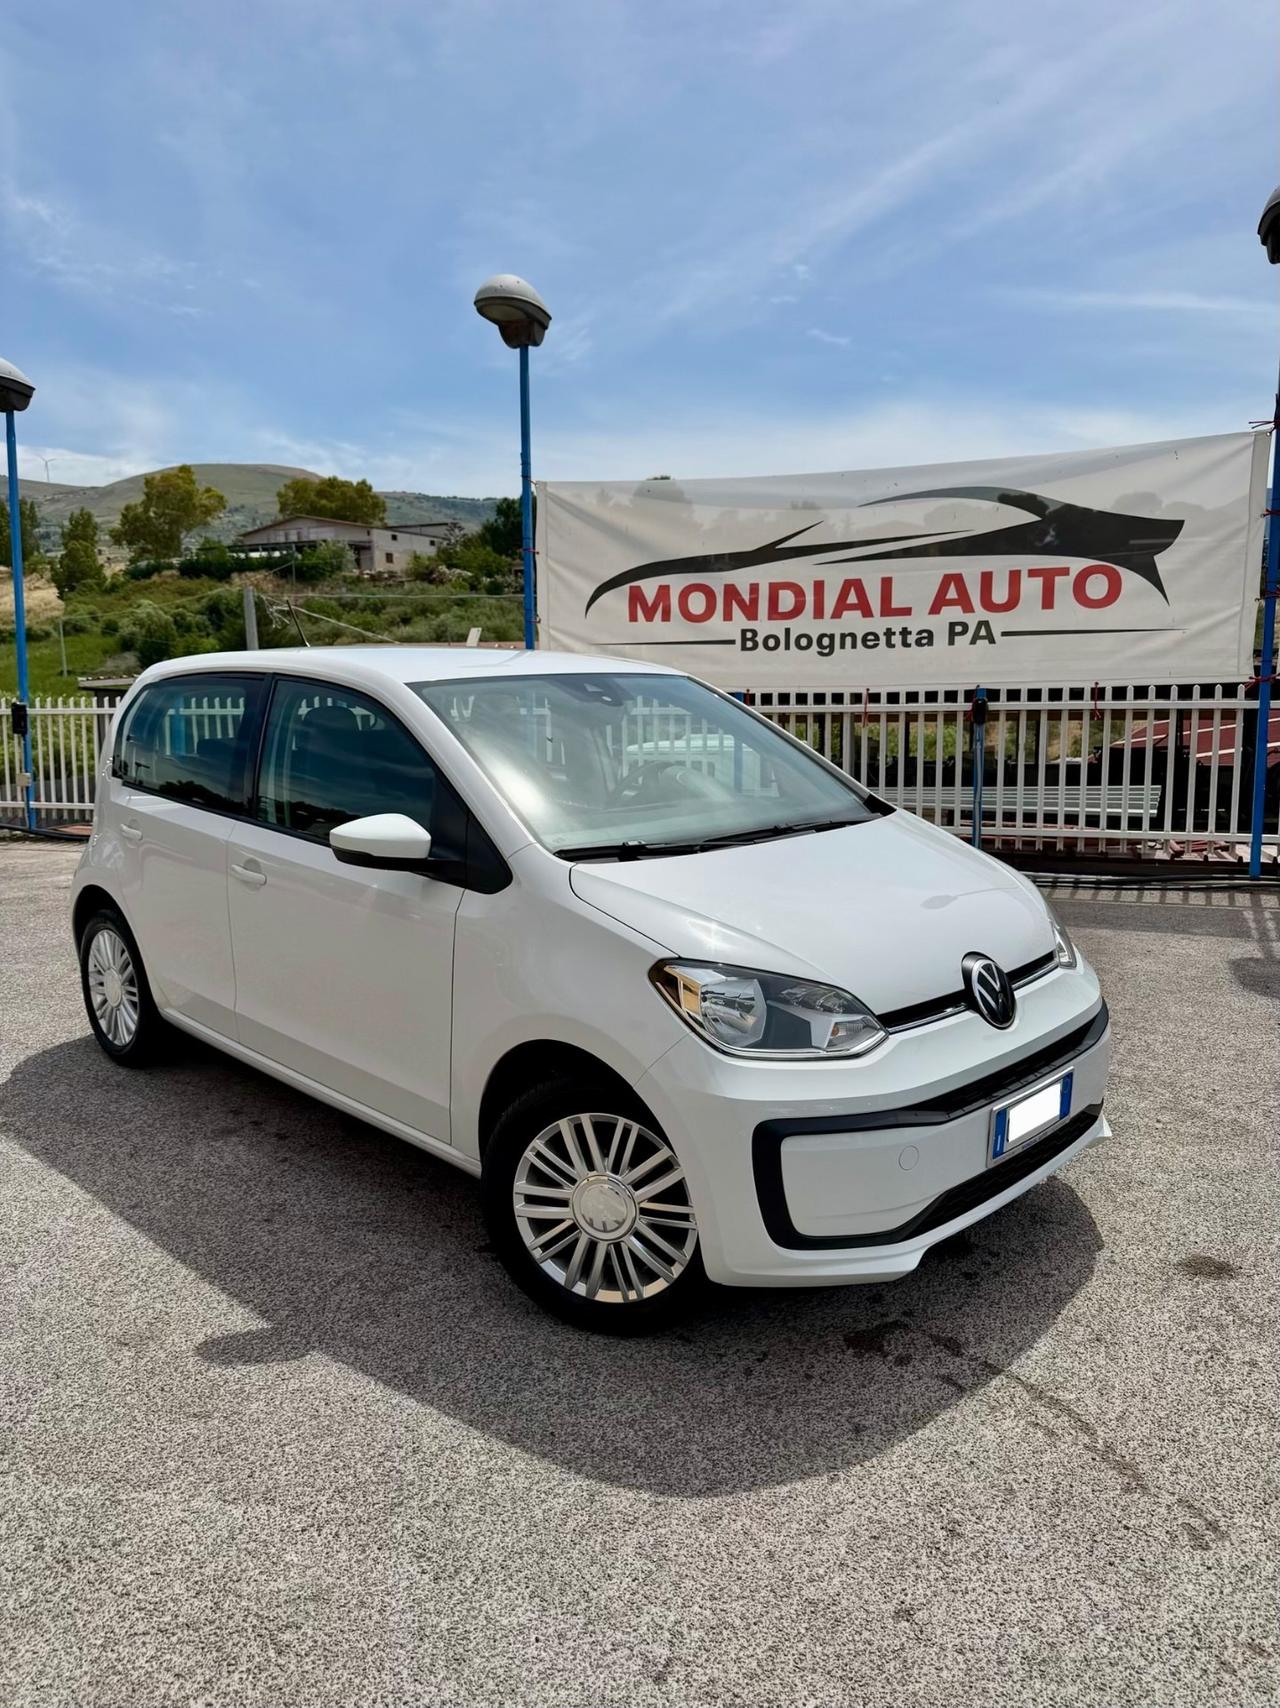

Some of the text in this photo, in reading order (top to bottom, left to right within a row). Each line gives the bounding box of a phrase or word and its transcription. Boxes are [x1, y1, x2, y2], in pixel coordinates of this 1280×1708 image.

[628, 564, 1123, 624] MONDIAL AUTO
[739, 619, 998, 658] Bolognetta PA
